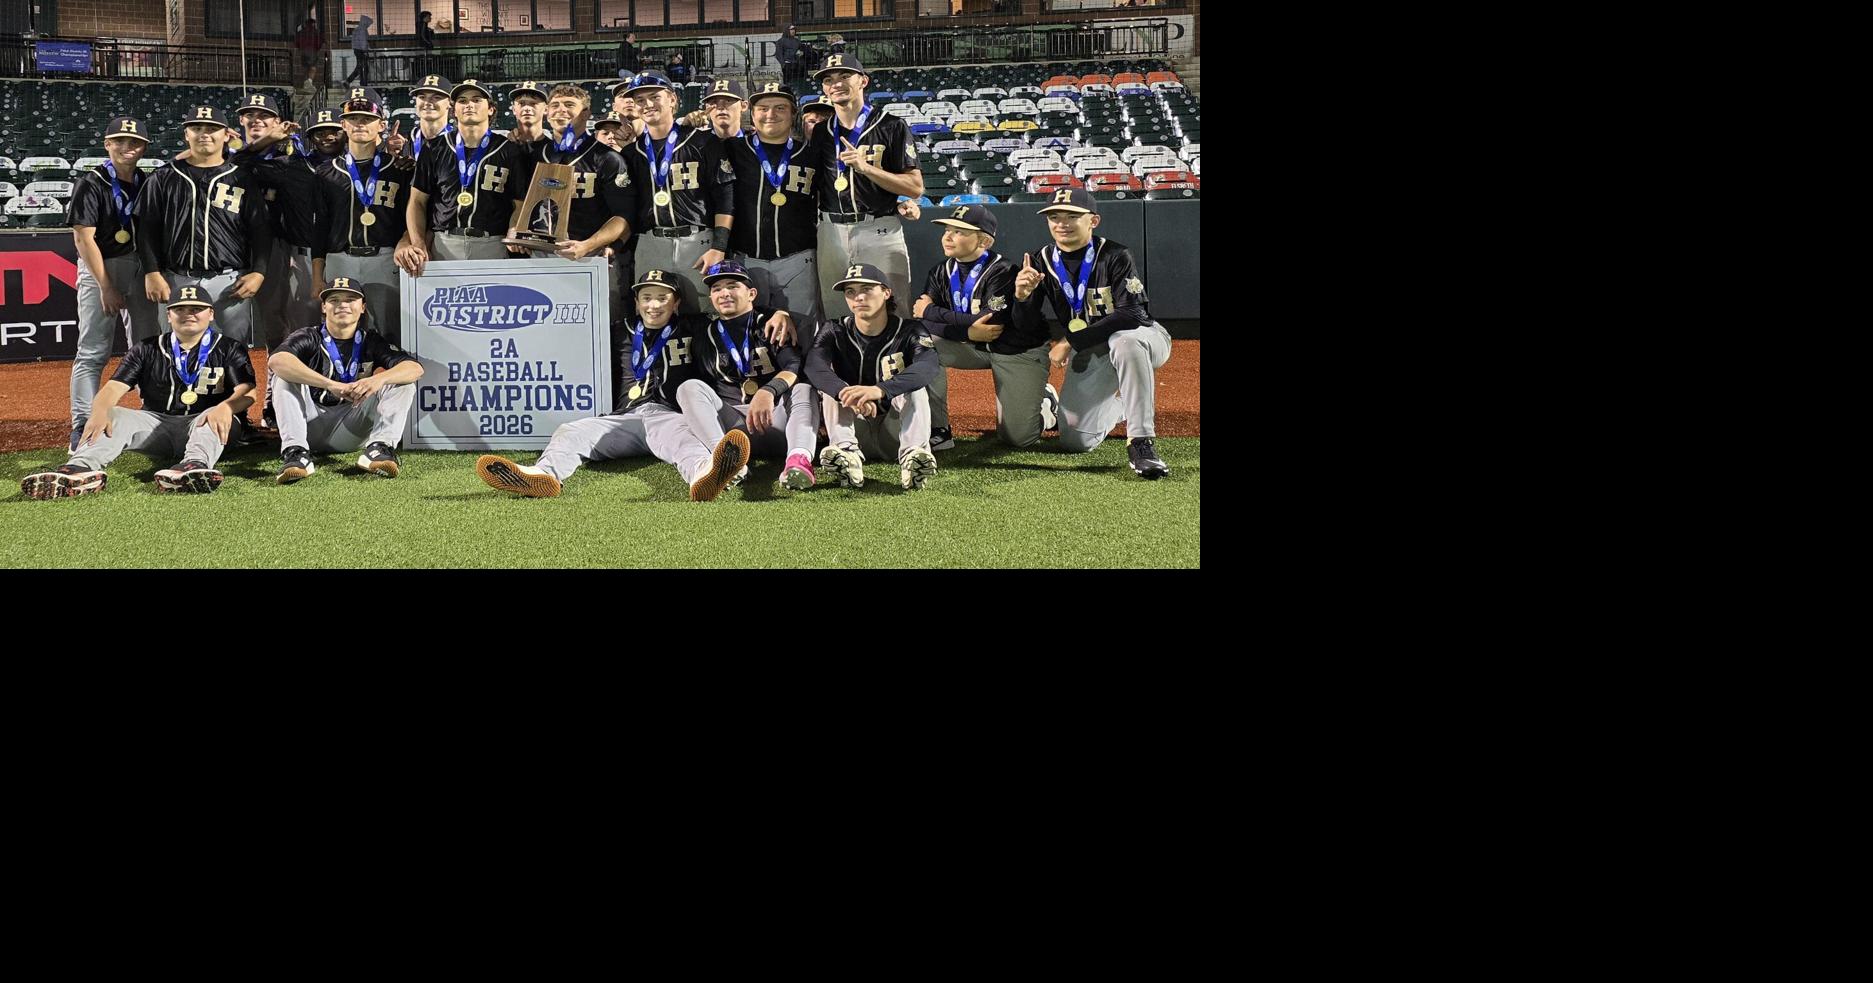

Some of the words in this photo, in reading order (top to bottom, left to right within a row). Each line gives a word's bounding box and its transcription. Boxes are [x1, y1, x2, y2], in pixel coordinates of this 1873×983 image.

[826, 55, 843, 68] H
[423, 75, 439, 87] H
[522, 81, 537, 90] H
[714, 80, 729, 91] H
[764, 82, 780, 93] H
[250, 95, 265, 106] H
[351, 88, 364, 99] H
[196, 107, 212, 119] H
[317, 111, 333, 123] H
[608, 111, 620, 121] H
[120, 120, 137, 133] H
[857, 144, 887, 170] H
[481, 164, 510, 193] H
[670, 162, 700, 191] H
[785, 165, 816, 195] H
[571, 172, 597, 198] H
[211, 182, 245, 214] H
[373, 180, 400, 209] H
[1053, 190, 1072, 204] H
[951, 205, 969, 219] H
[646, 270, 663, 281] H
[845, 265, 863, 279] H
[333, 278, 349, 288] H
[181, 287, 197, 299] H
[433, 286, 488, 304] PIAA
[1087, 286, 1115, 316] H
[428, 304, 549, 326] DISTRICT
[553, 303, 588, 324] III
[490, 338, 519, 359] 2A
[666, 336, 692, 366] H
[447, 361, 563, 383] BASEBALL
[881, 352, 905, 381] H
[195, 366, 225, 395] H
[419, 384, 593, 412] CHAMPIONS
[479, 414, 533, 435] 2026
